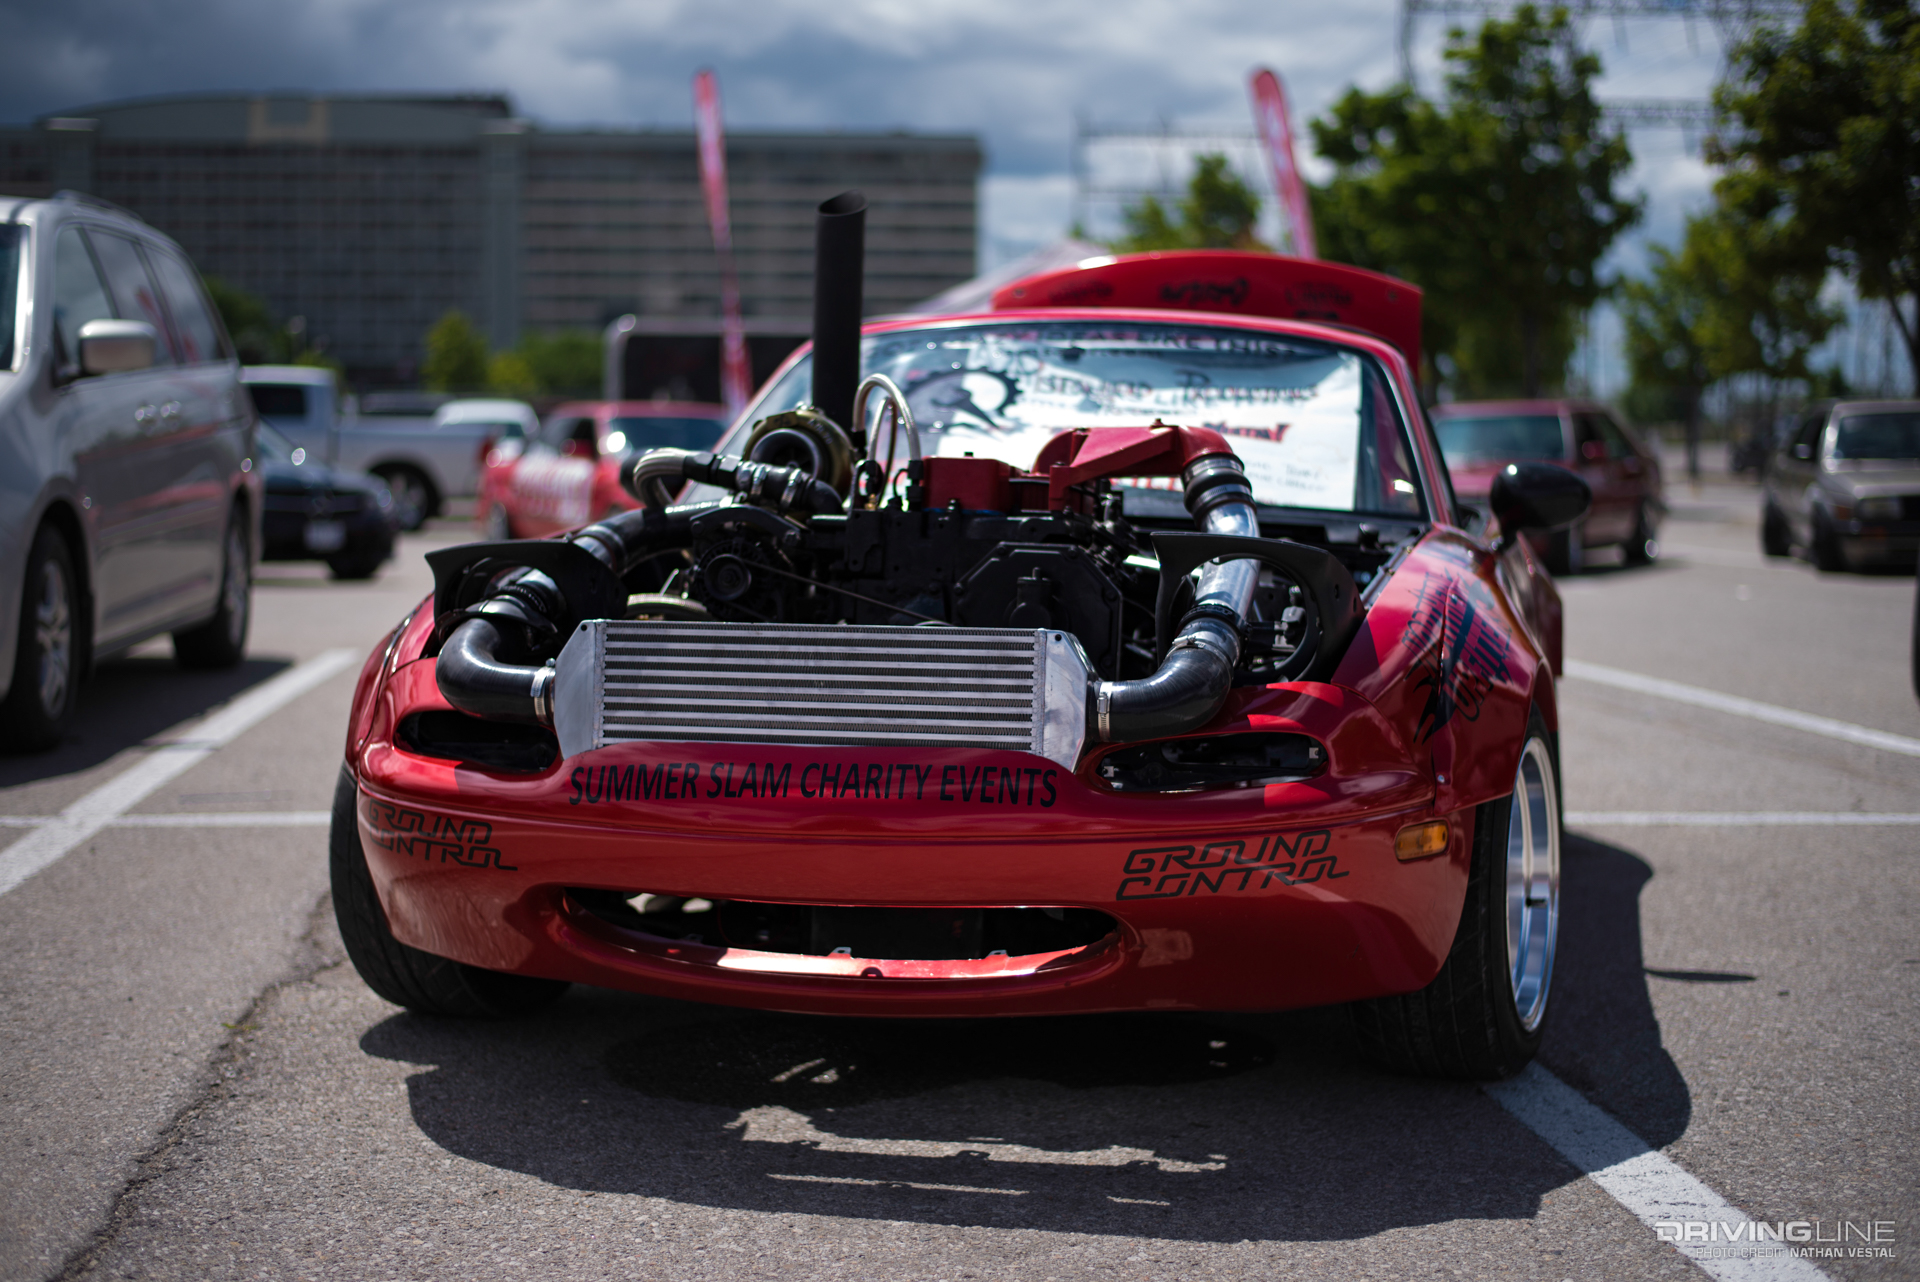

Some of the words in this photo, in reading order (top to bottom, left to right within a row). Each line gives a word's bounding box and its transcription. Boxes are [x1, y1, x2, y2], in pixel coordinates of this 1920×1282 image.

[569, 762, 699, 806] SUMMER
[706, 762, 792, 799] SLAM
[800, 763, 932, 800] CHARITY
[940, 765, 1058, 808] EVENTS
[368, 799, 492, 845] GROUND
[369, 823, 518, 871] CONTROL
[1123, 829, 1331, 875] GROUND
[1116, 855, 1350, 900] CONTROL
